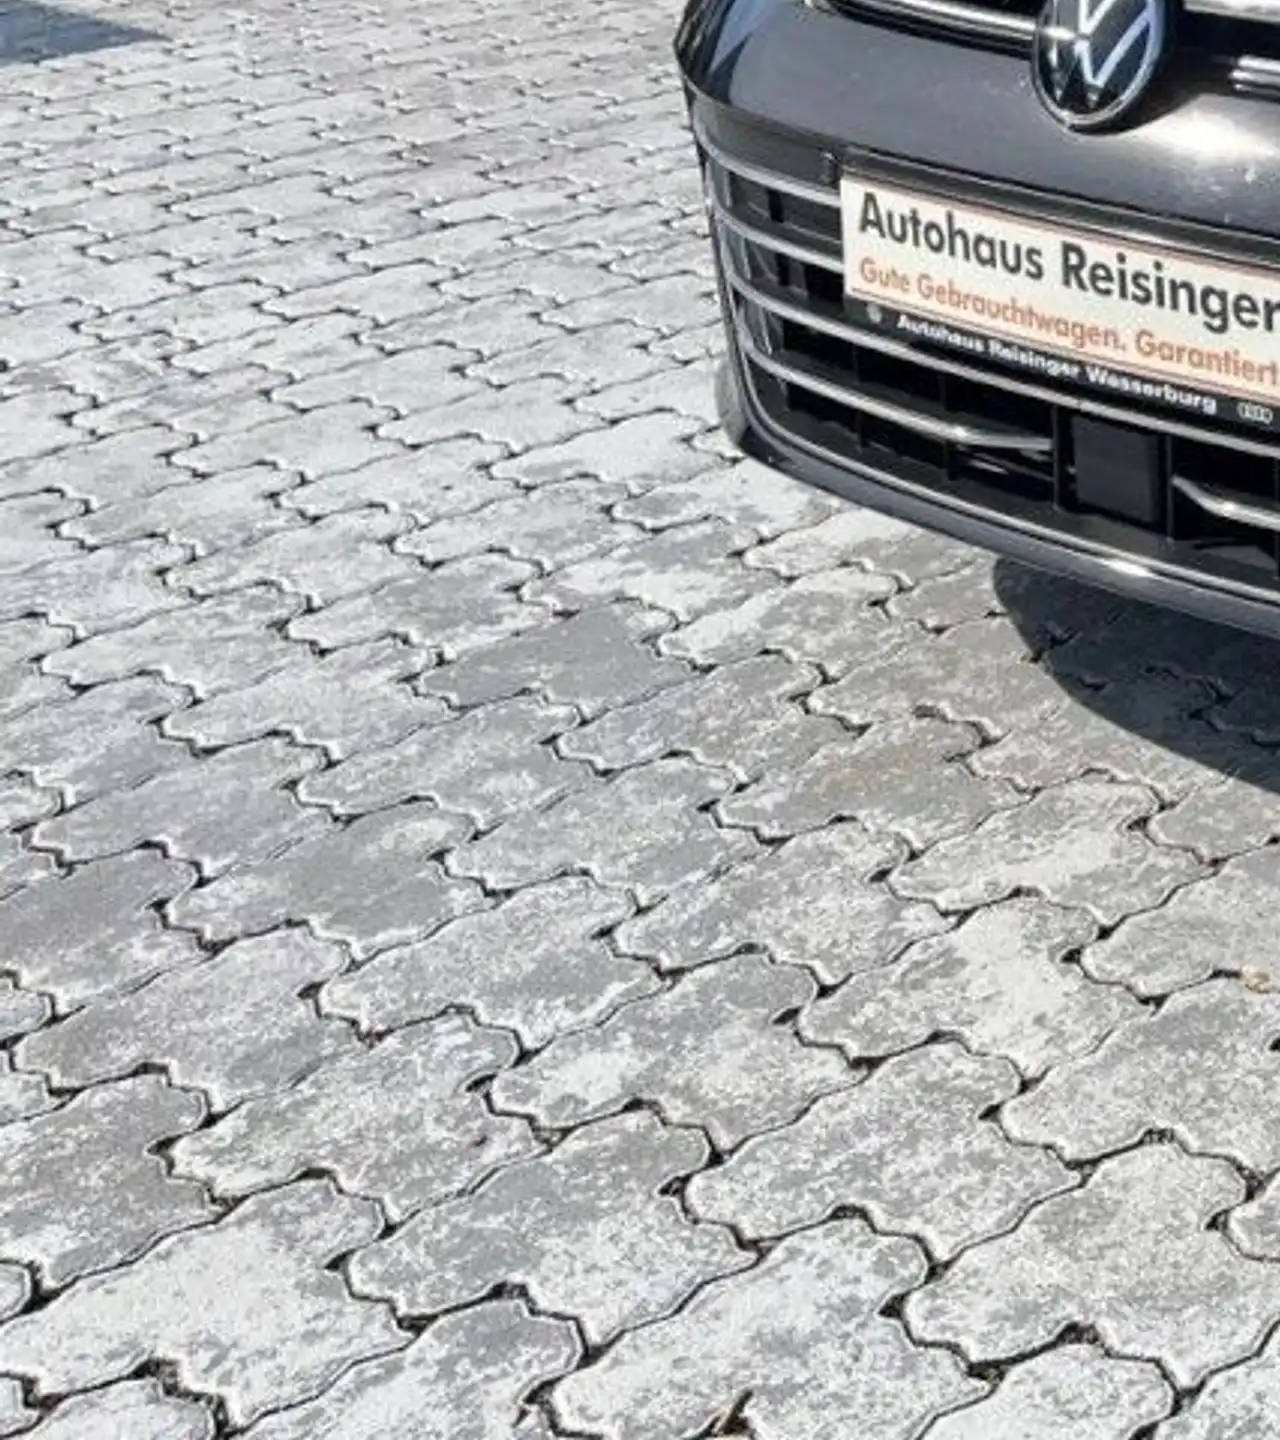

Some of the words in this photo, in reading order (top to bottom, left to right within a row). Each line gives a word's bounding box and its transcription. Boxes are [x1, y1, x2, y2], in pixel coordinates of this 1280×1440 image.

[859, 191, 1044, 281] Autohaus
[859, 256, 911, 294] Gute
[916, 272, 1128, 350] Gebrauchtwagen.
[896, 314, 985, 354] Autohaus
[987, 337, 1083, 380] Reisinger
[1086, 363, 1217, 416] Wasserburg
